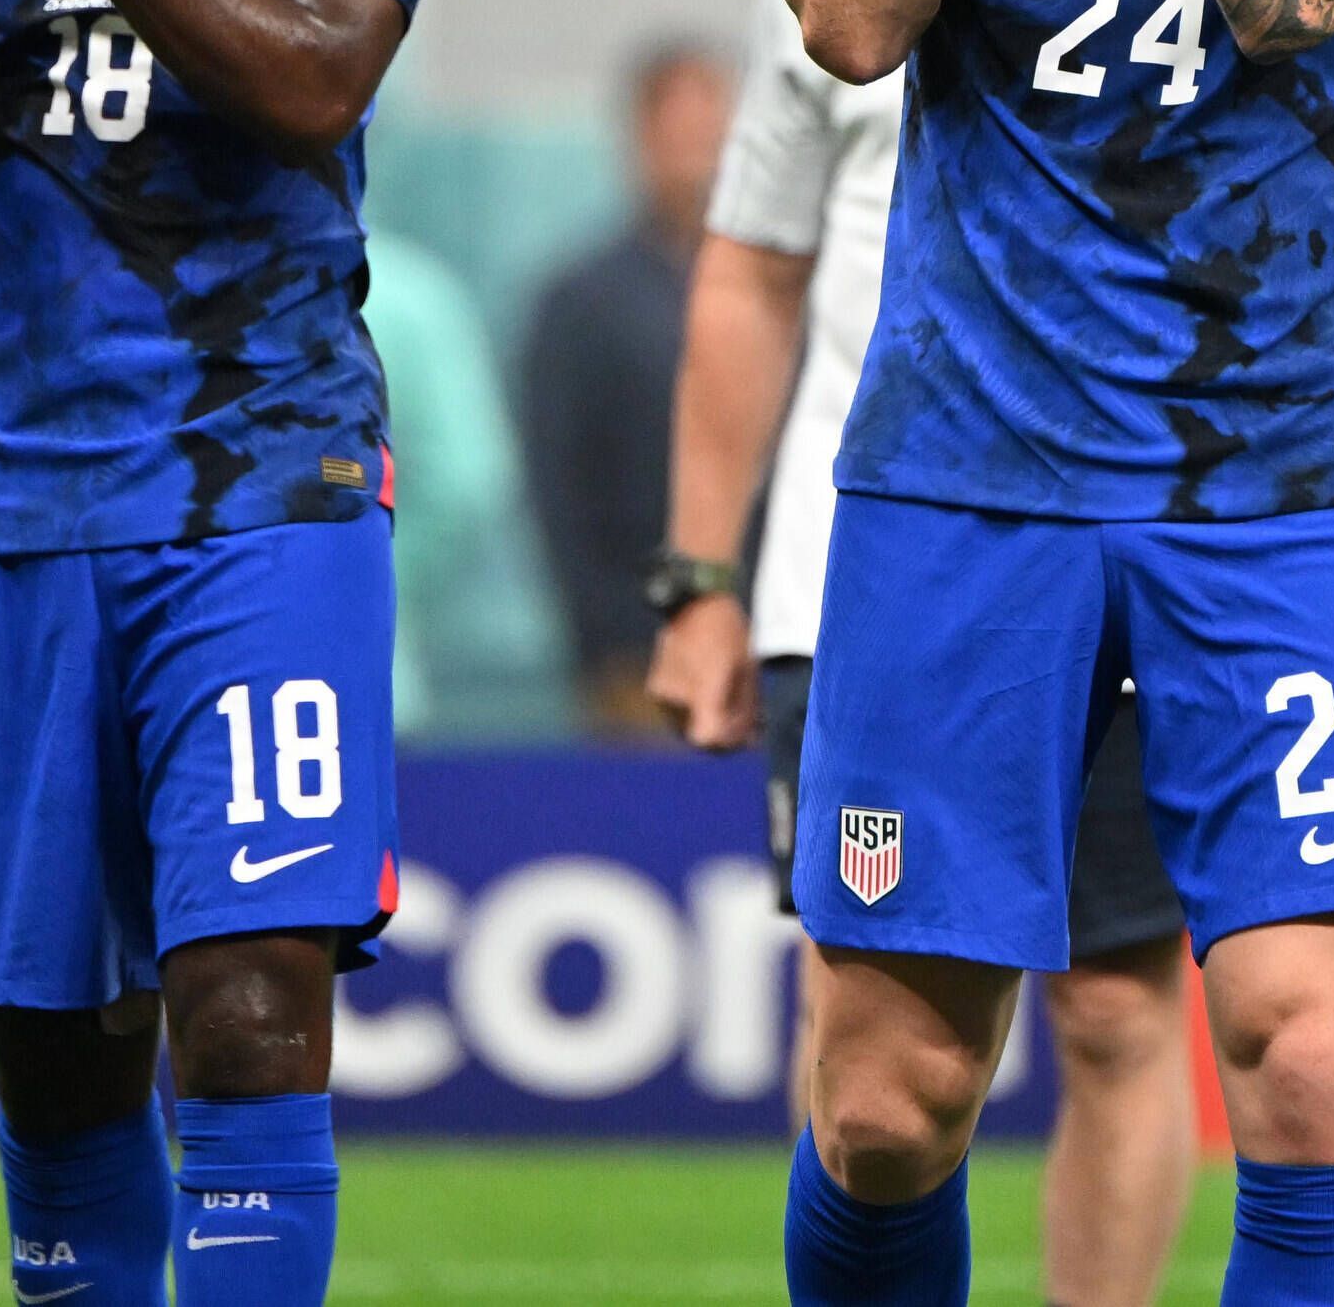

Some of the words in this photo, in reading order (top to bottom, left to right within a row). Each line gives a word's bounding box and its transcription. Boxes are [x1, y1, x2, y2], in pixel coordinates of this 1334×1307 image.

[41, 14, 153, 143] 18
[217, 679, 342, 824] 18
[846, 814, 897, 850] USA
[13, 1235, 76, 1266] USA
